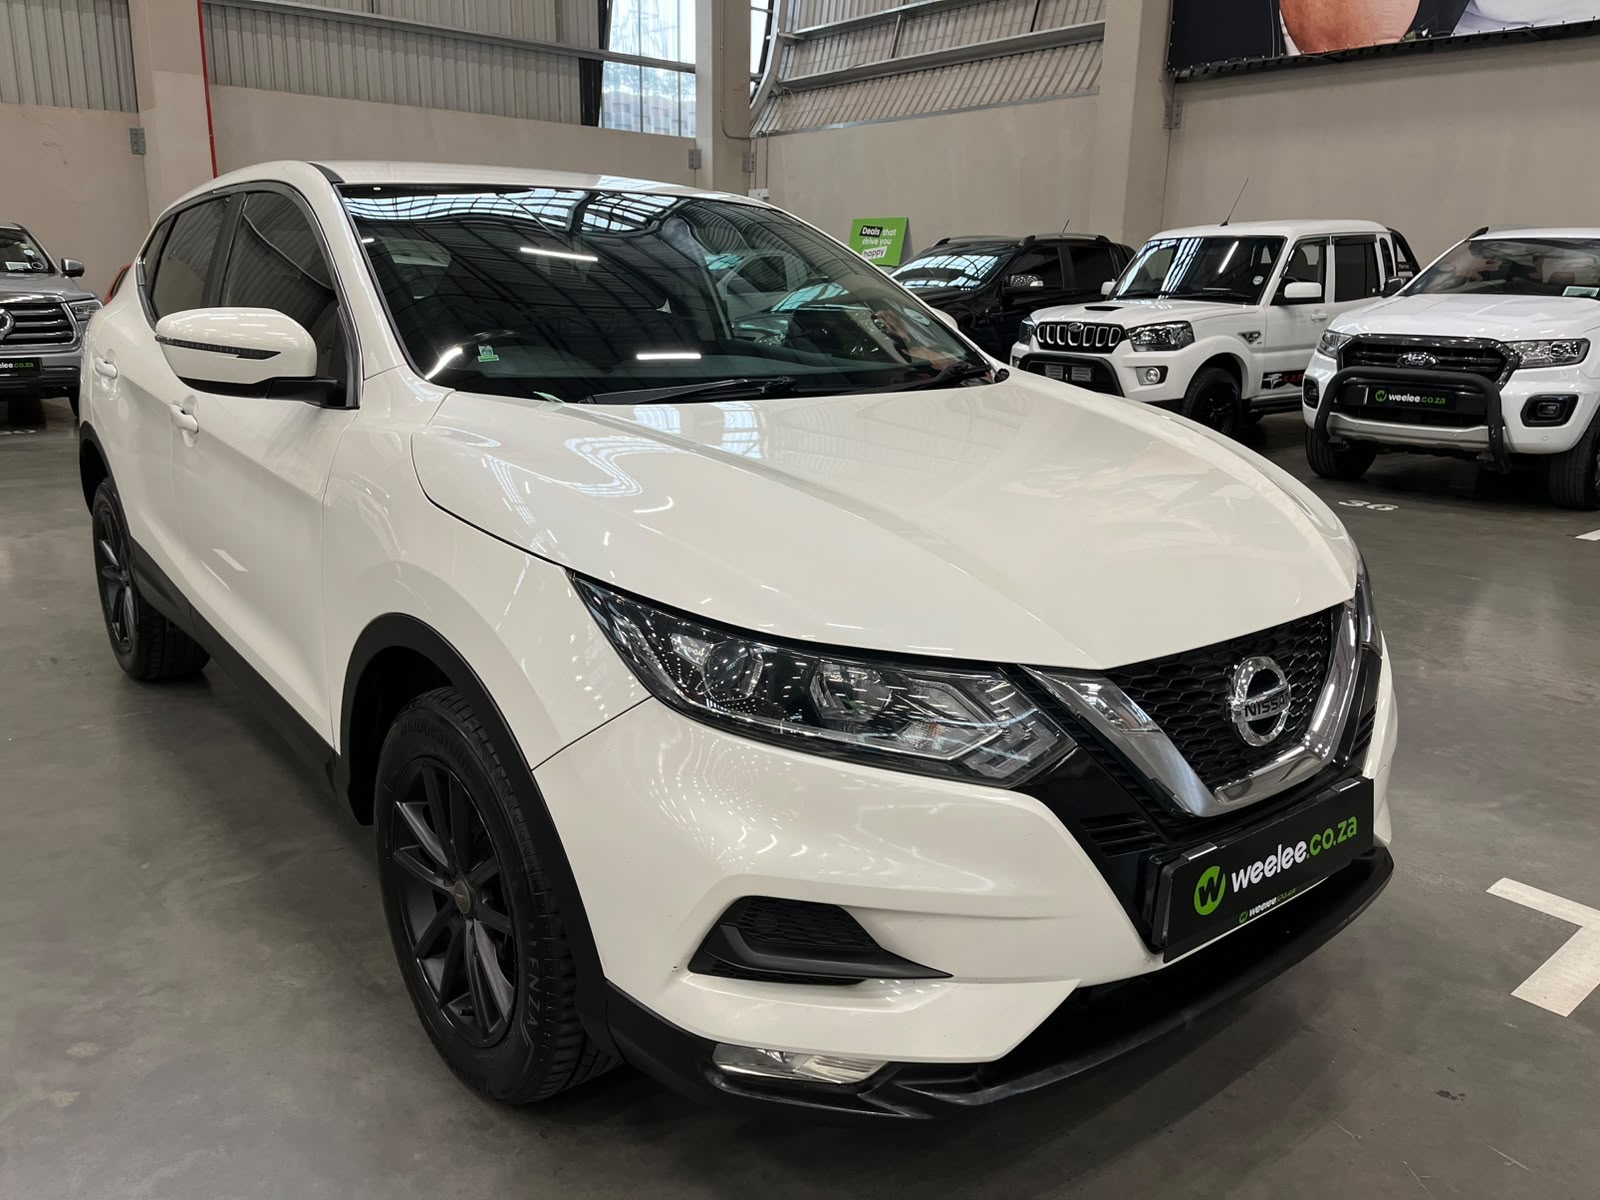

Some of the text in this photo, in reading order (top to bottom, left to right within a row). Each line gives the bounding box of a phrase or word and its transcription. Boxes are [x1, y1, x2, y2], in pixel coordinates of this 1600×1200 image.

[862, 227, 880, 235] Deals
[862, 237, 879, 245] drive
[863, 249, 885, 257] happy
[1388, 393, 1446, 405] weelee.co.za
[1244, 691, 1290, 717] NISSAN
[1231, 816, 1358, 892] weelee.co.za
